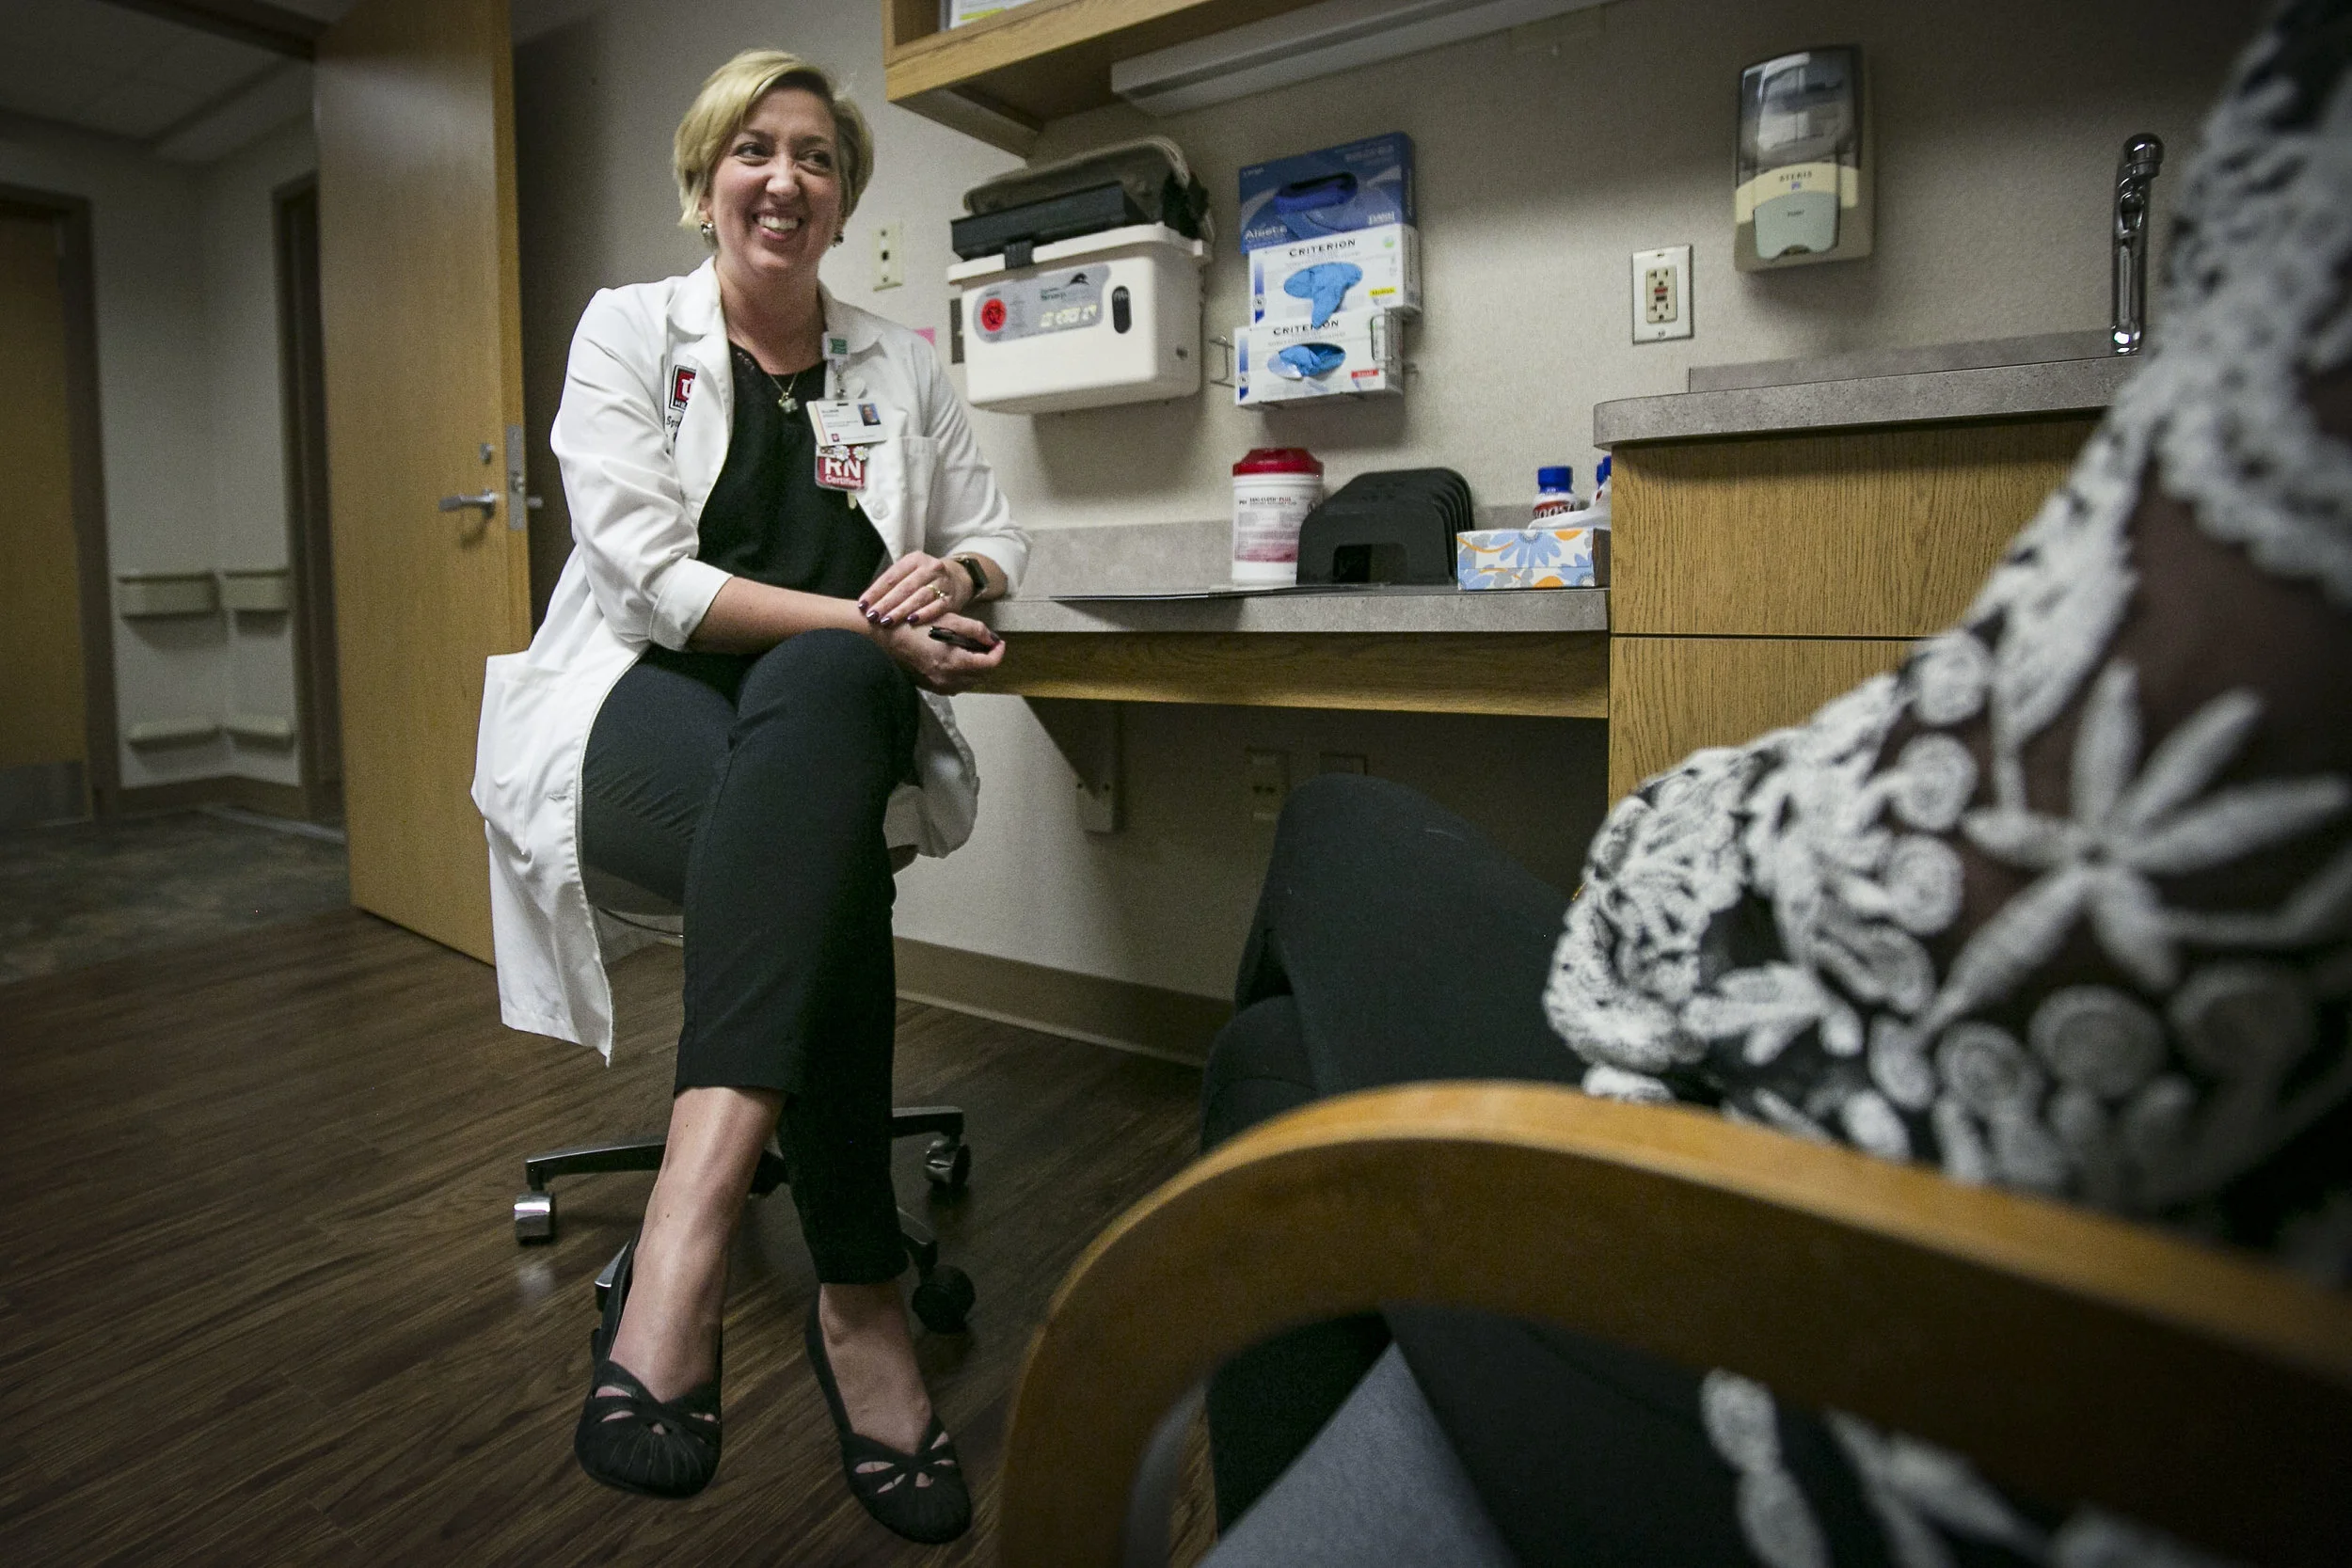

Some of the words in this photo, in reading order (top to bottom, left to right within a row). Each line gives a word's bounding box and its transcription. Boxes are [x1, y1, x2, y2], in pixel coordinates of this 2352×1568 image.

[1289, 238, 1356, 257] CRITERION
[1273, 320, 1339, 336] CRITEON
[825, 457, 861, 479] RN
